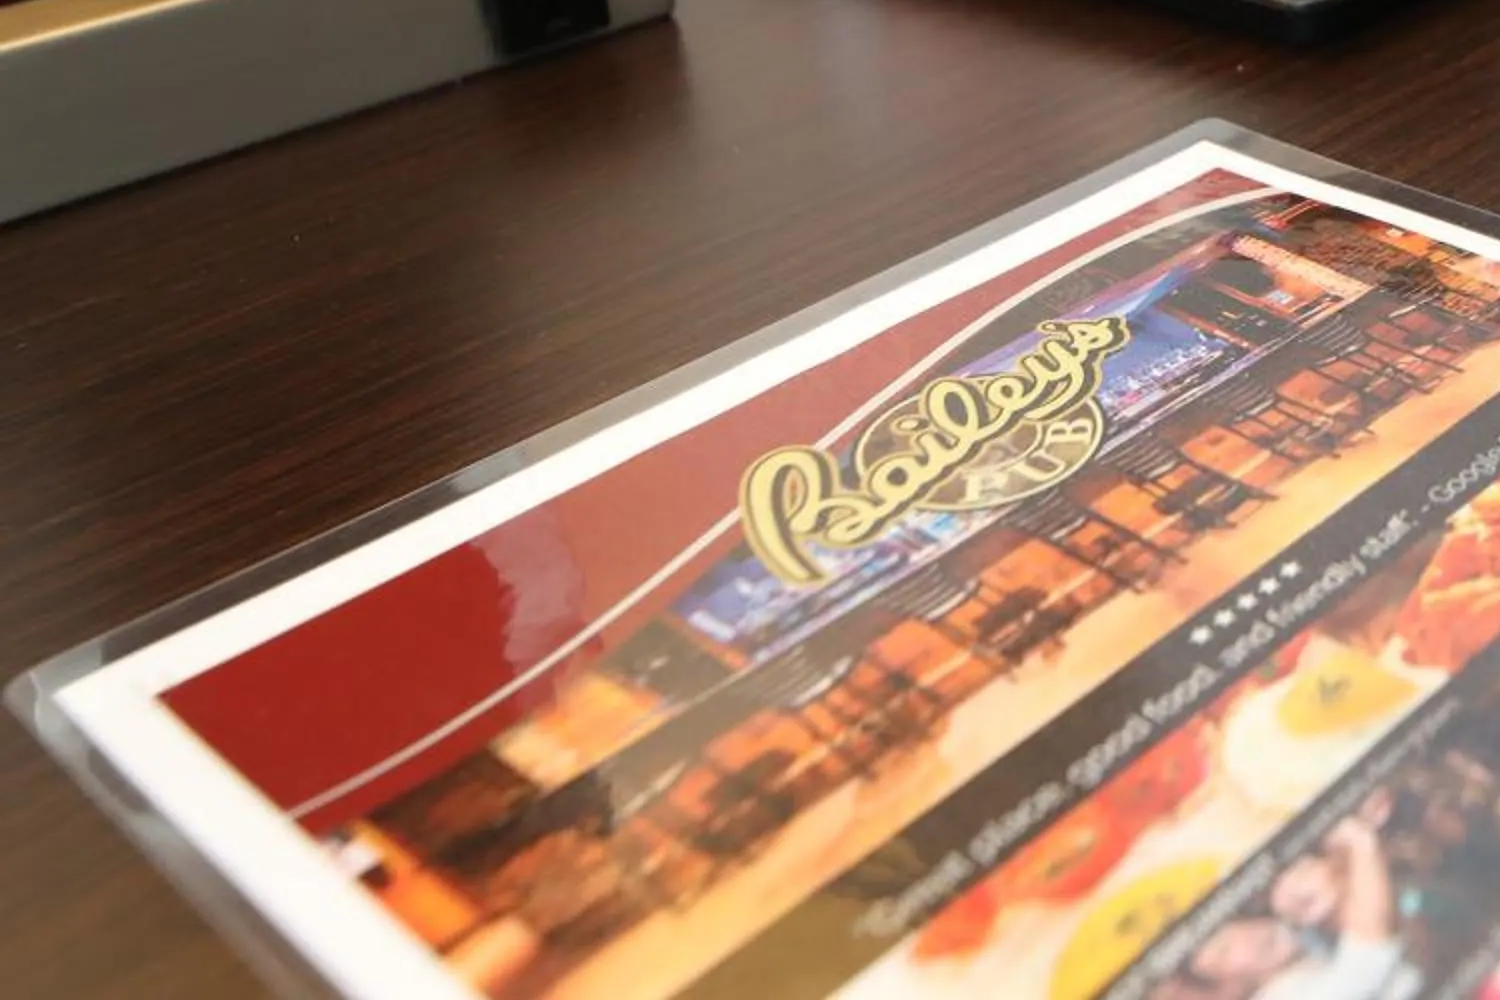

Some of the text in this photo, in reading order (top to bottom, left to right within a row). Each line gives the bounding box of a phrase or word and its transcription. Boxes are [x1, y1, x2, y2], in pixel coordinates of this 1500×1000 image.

[743, 316, 1131, 584] Bailey's
[965, 417, 1096, 501] PUB
[1066, 712, 1152, 789] good
[1219, 619, 1275, 668] and
[1265, 554, 1367, 628] friendly
